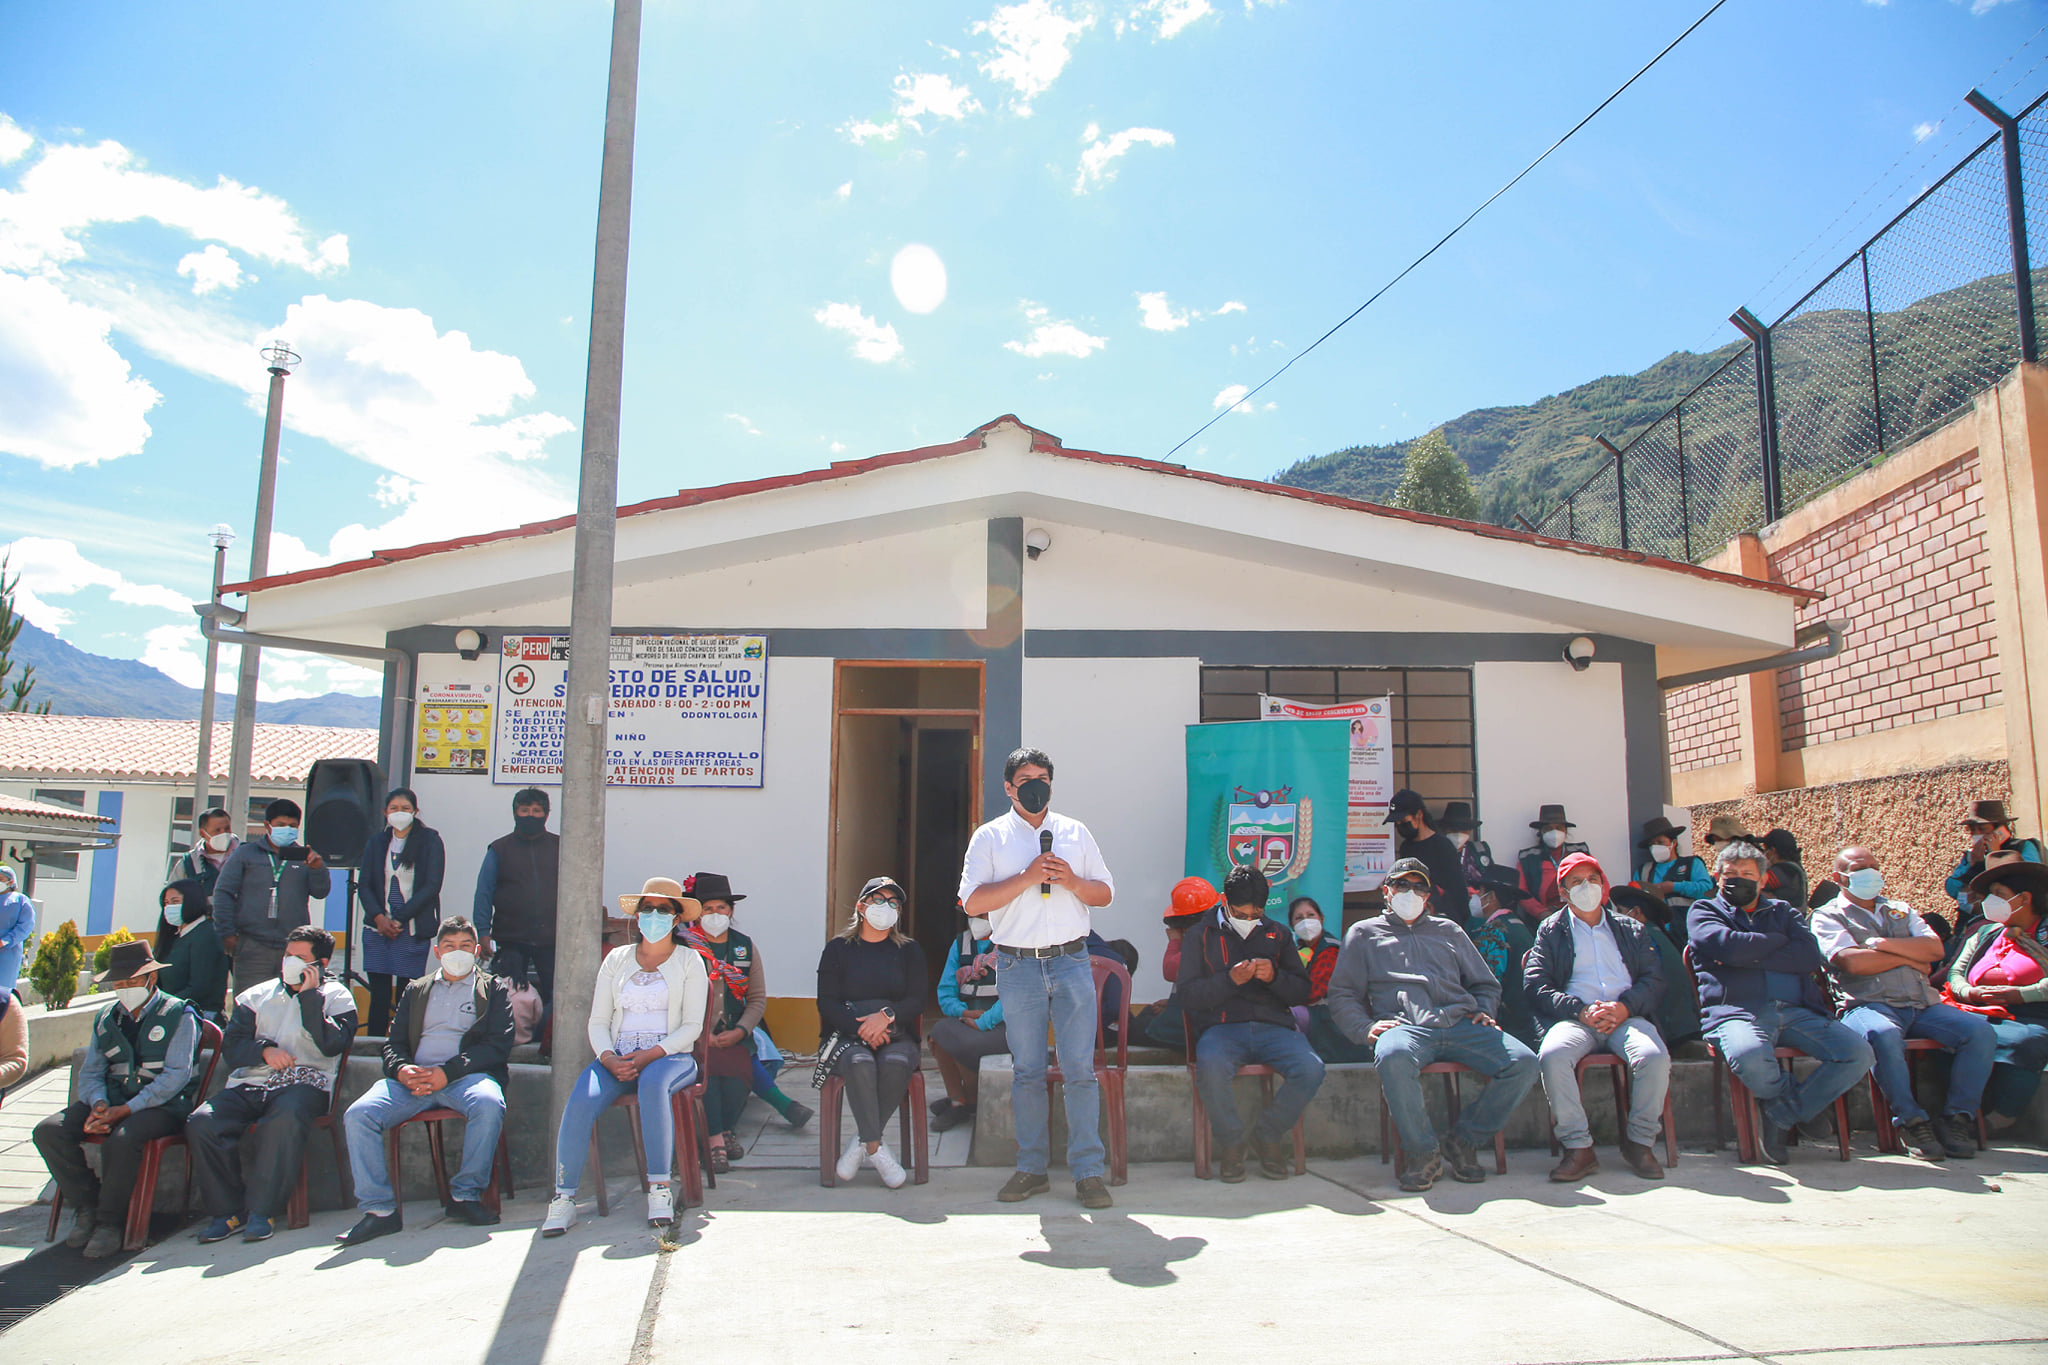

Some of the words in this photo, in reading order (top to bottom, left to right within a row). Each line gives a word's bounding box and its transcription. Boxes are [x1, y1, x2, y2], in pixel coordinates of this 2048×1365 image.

[551, 638, 570, 649] Minis
[522, 642, 549, 656] PERU
[651, 670, 676, 683] DE
[684, 670, 751, 683] SALUD
[609, 685, 660, 698] EDRO
[666, 685, 688, 698] DE
[692, 685, 760, 698] PICHIU
[733, 700, 751, 708] PM
[533, 710, 567, 718] ATIEN
[608, 710, 625, 718] EN
[681, 711, 758, 719] ODONTOLOGIA
[615, 732, 647, 741] NIÑO
[653, 751, 759, 759] DESARROLLO
[713, 759, 742, 767] AREAS
[502, 765, 564, 774] EMERGEN
[614, 766, 675, 775] ATENCION
[681, 767, 697, 775] DE
[704, 767, 754, 776] PARTOS
[607, 776, 625, 784] 24
[630, 776, 675, 784] HORAS
